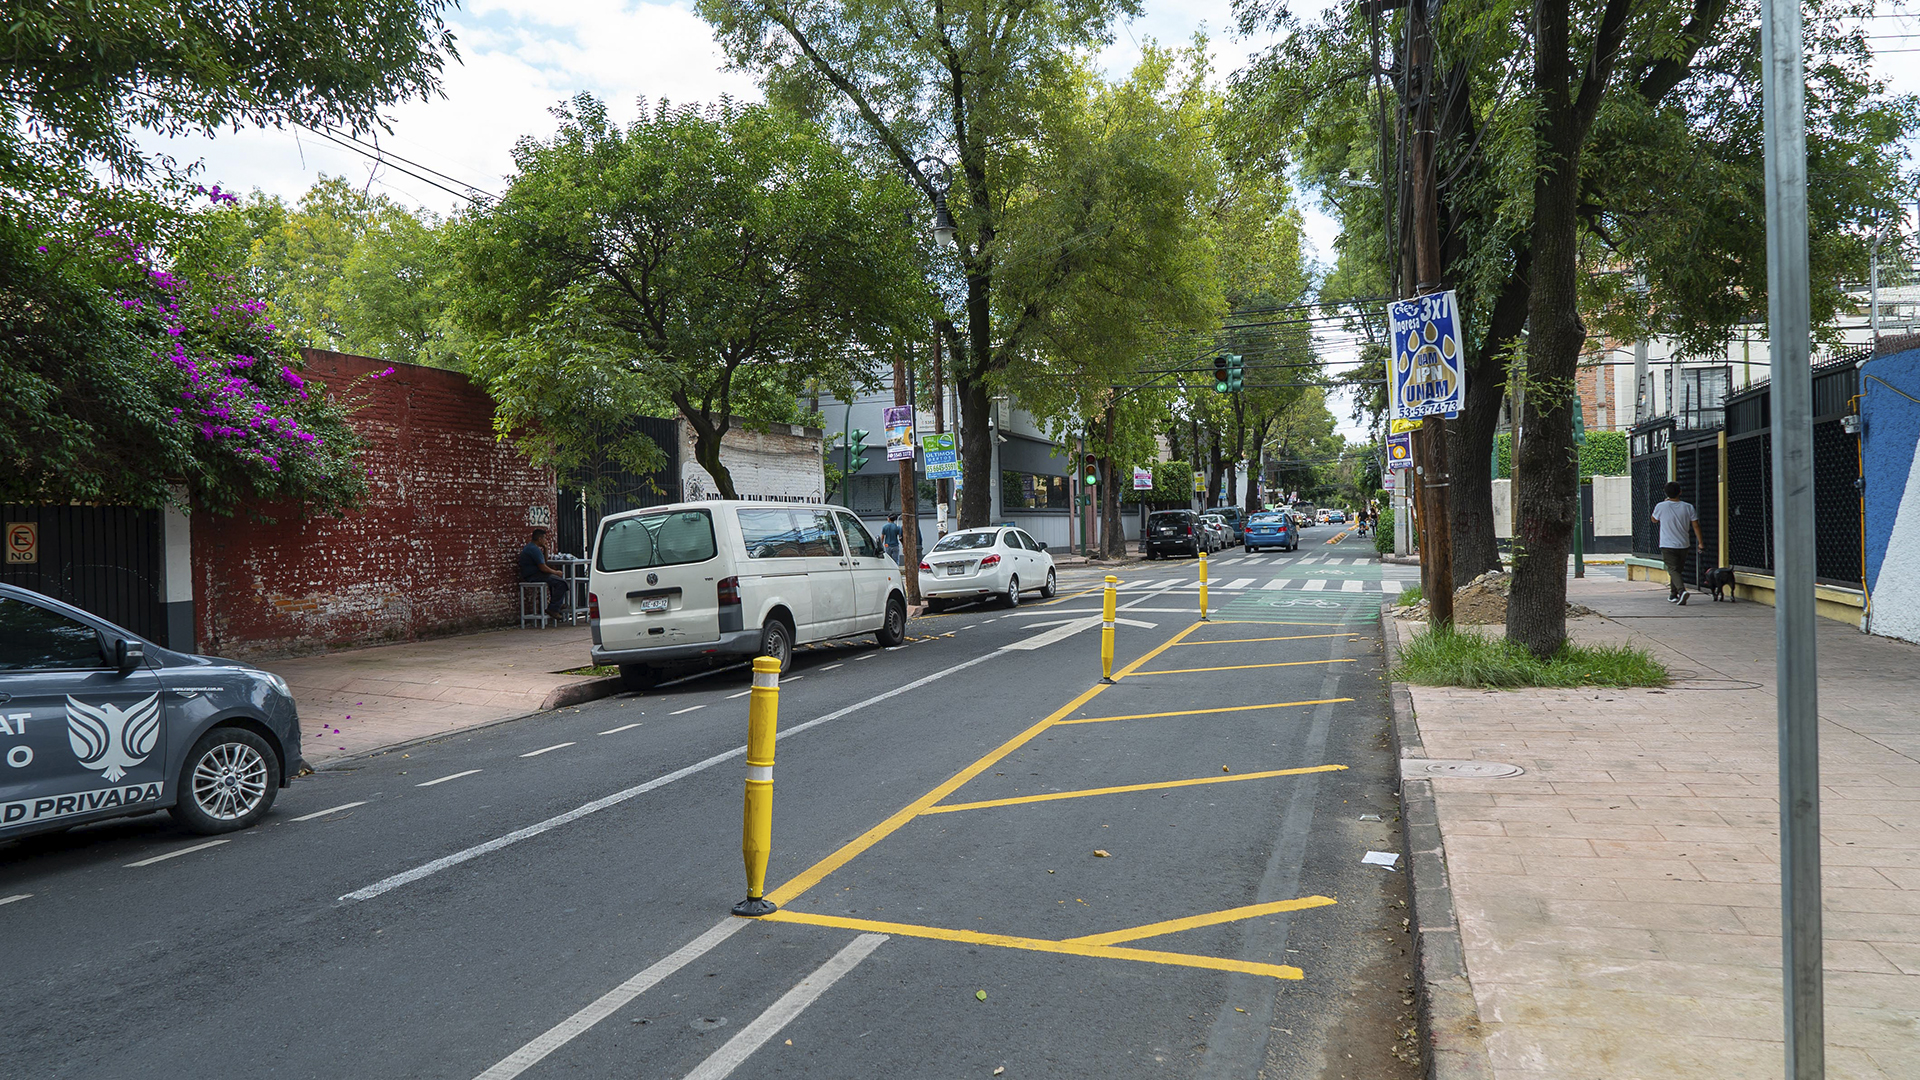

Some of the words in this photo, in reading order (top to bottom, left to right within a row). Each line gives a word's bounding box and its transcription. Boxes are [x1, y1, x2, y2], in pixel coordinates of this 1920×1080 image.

[1394, 317, 1420, 335] Ingresa
[1417, 351, 1438, 366] UAM
[1416, 364, 1443, 383] IPN
[1406, 379, 1449, 402] UNAM
[530, 505, 550, 525] 328
[11, 552, 33, 561] NO
[6, 745, 34, 768] O
[0, 803, 27, 823] D
[33, 783, 162, 819] PRIVADA
